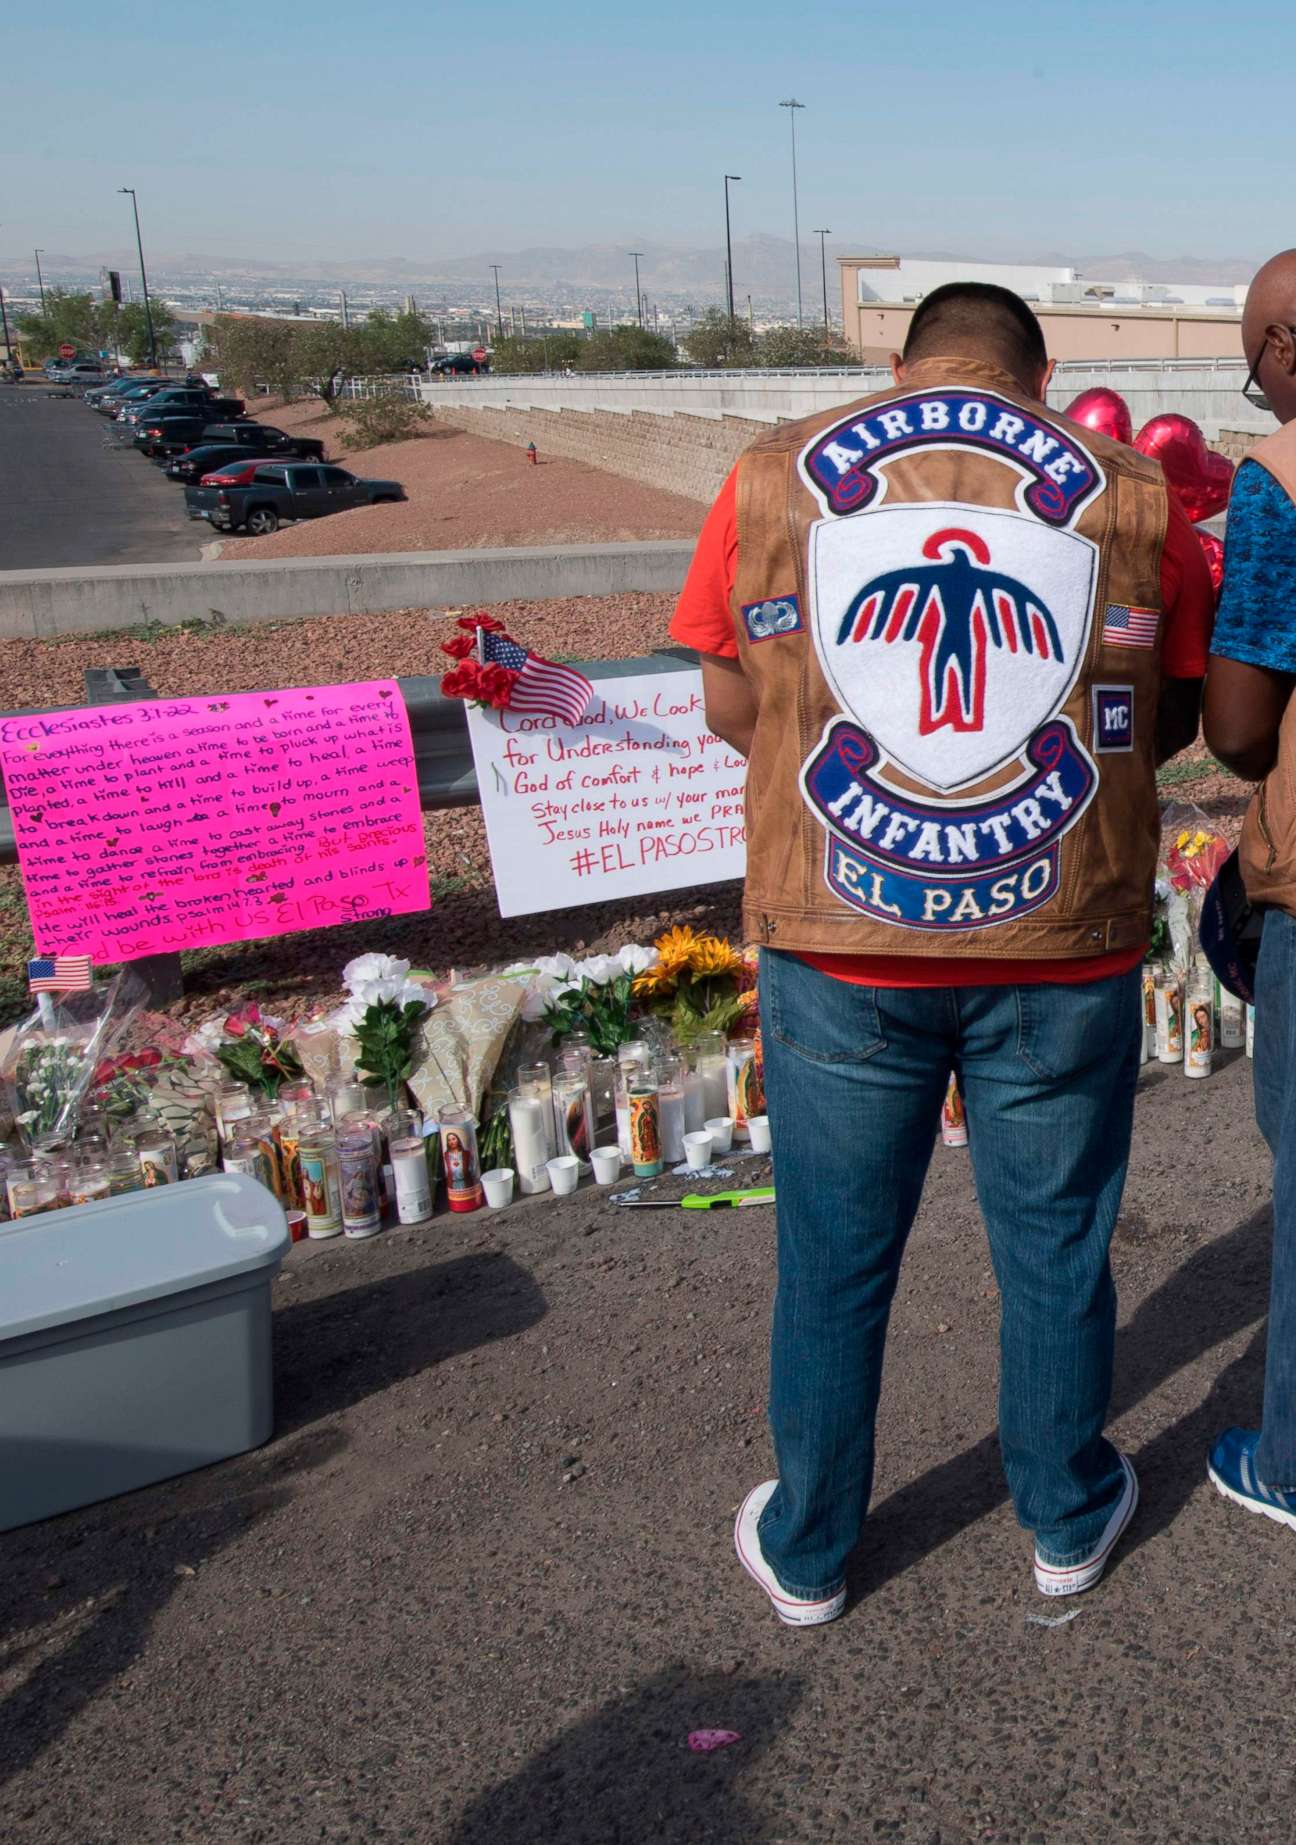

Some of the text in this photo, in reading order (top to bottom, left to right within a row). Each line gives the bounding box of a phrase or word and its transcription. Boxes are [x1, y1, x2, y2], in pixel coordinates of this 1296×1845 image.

[821, 400, 1086, 485] AIRBORNE
[1, 715, 133, 743] Ecclesiastes
[2, 751, 28, 764] For
[109, 738, 150, 752] there
[183, 725, 230, 737] season
[235, 717, 263, 729] and
[282, 710, 317, 721] time
[321, 707, 345, 717] for
[350, 701, 393, 715] every
[653, 693, 706, 717] Look
[1104, 704, 1129, 733] MC
[8, 766, 70, 784] matter
[75, 760, 122, 774] under
[130, 751, 181, 765] heaven
[198, 742, 228, 752] time
[237, 737, 248, 746] to
[272, 729, 303, 738] born
[306, 720, 332, 733] and
[349, 714, 377, 724] time
[385, 711, 399, 720] to
[60, 778, 96, 789] time
[104, 774, 118, 783] to
[124, 765, 164, 782] plant
[170, 760, 195, 772] and
[219, 751, 251, 760] time
[259, 747, 274, 755] to
[280, 737, 318, 753] pluck
[324, 735, 338, 744] up
[344, 726, 385, 740] what
[387, 723, 402, 734] is
[94, 789, 130, 801] time
[136, 785, 152, 793] to
[195, 772, 221, 784] and
[245, 762, 279, 774] time
[288, 758, 302, 767] to
[372, 740, 403, 750] time
[502, 738, 539, 768] for
[514, 771, 548, 793] God
[556, 770, 576, 790] of
[581, 764, 642, 788] comfort
[669, 762, 704, 779] hope
[19, 824, 37, 834] to
[102, 810, 139, 821] down
[144, 804, 171, 815] and
[190, 794, 223, 805] time
[232, 789, 245, 797] to
[252, 778, 292, 795] build
[335, 764, 368, 776] time
[376, 755, 416, 768] weep
[19, 780, 384, 849] and time to laugh time to mourn and
[531, 800, 568, 820] Stay
[571, 798, 605, 814] close
[609, 793, 627, 809] to
[631, 797, 649, 807] us
[655, 791, 672, 810] w/
[676, 792, 708, 808] your
[827, 771, 1075, 863] INFANTRY
[27, 856, 66, 867] time
[72, 851, 90, 862] to
[168, 838, 198, 848] time
[209, 833, 222, 841] to
[229, 826, 261, 839] cast
[267, 817, 304, 832] away
[309, 806, 354, 821] stones
[359, 797, 385, 810] and
[27, 873, 61, 883] time
[86, 860, 138, 879] gather
[144, 852, 193, 865] stones
[202, 841, 261, 859] together
[283, 831, 316, 842] time
[323, 826, 336, 834] to
[342, 813, 403, 830] embrace
[538, 819, 591, 845] Jesus
[599, 818, 630, 839] Holy
[637, 818, 675, 832] name
[681, 813, 702, 824] we
[30, 886, 58, 897] and
[78, 878, 112, 888] time
[200, 859, 232, 869] from
[39, 858, 408, 934] He will heal the broken hearted and blinds up
[834, 849, 1053, 922] EL PASO
[43, 906, 224, 947] their wounds psalm
[116, 940, 157, 955] be
[162, 919, 225, 943] with
[277, 901, 305, 923] El
[306, 894, 369, 915] Paso
